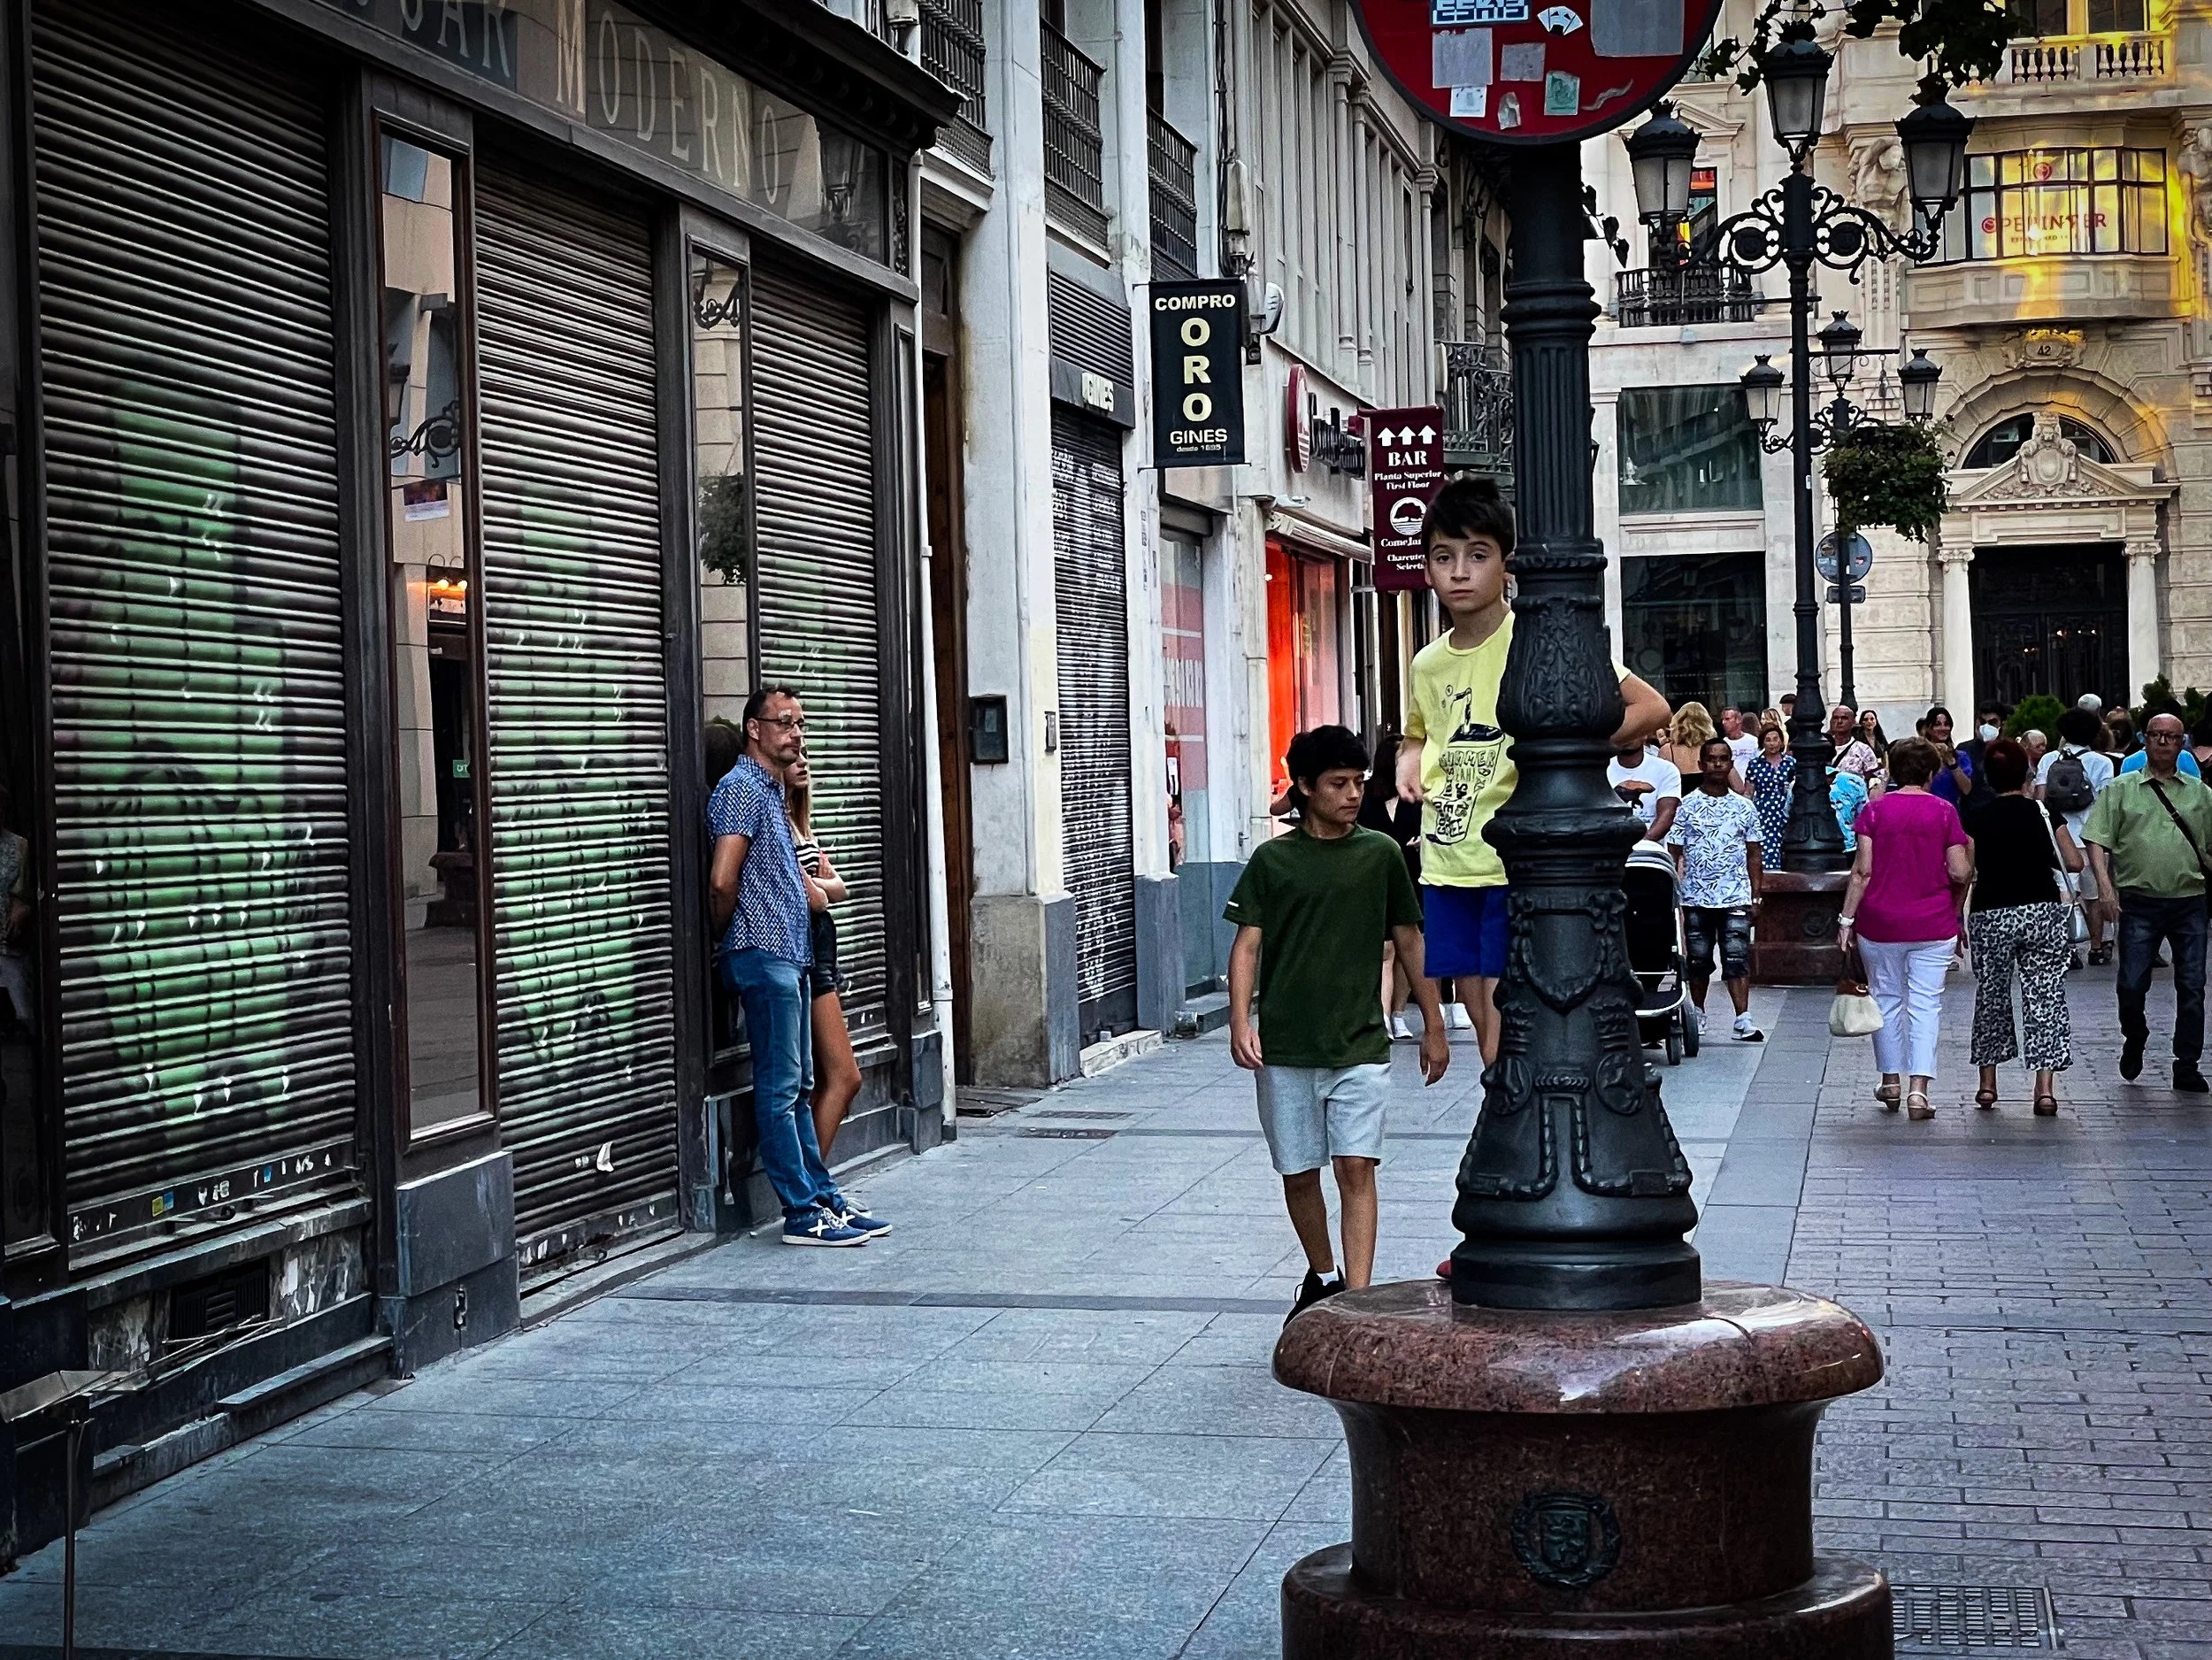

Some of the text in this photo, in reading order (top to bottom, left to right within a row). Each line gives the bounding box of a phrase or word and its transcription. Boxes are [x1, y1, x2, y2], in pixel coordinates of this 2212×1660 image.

[554, 0, 779, 204] MODERNO
[1155, 294, 1236, 311] COMPRO
[2037, 345, 2051, 357] 42
[1180, 317, 1212, 422] ORO
[1170, 428, 1228, 444] GINES
[1387, 450, 1427, 466] BAR
[1374, 470, 1442, 480] Planta Superior
